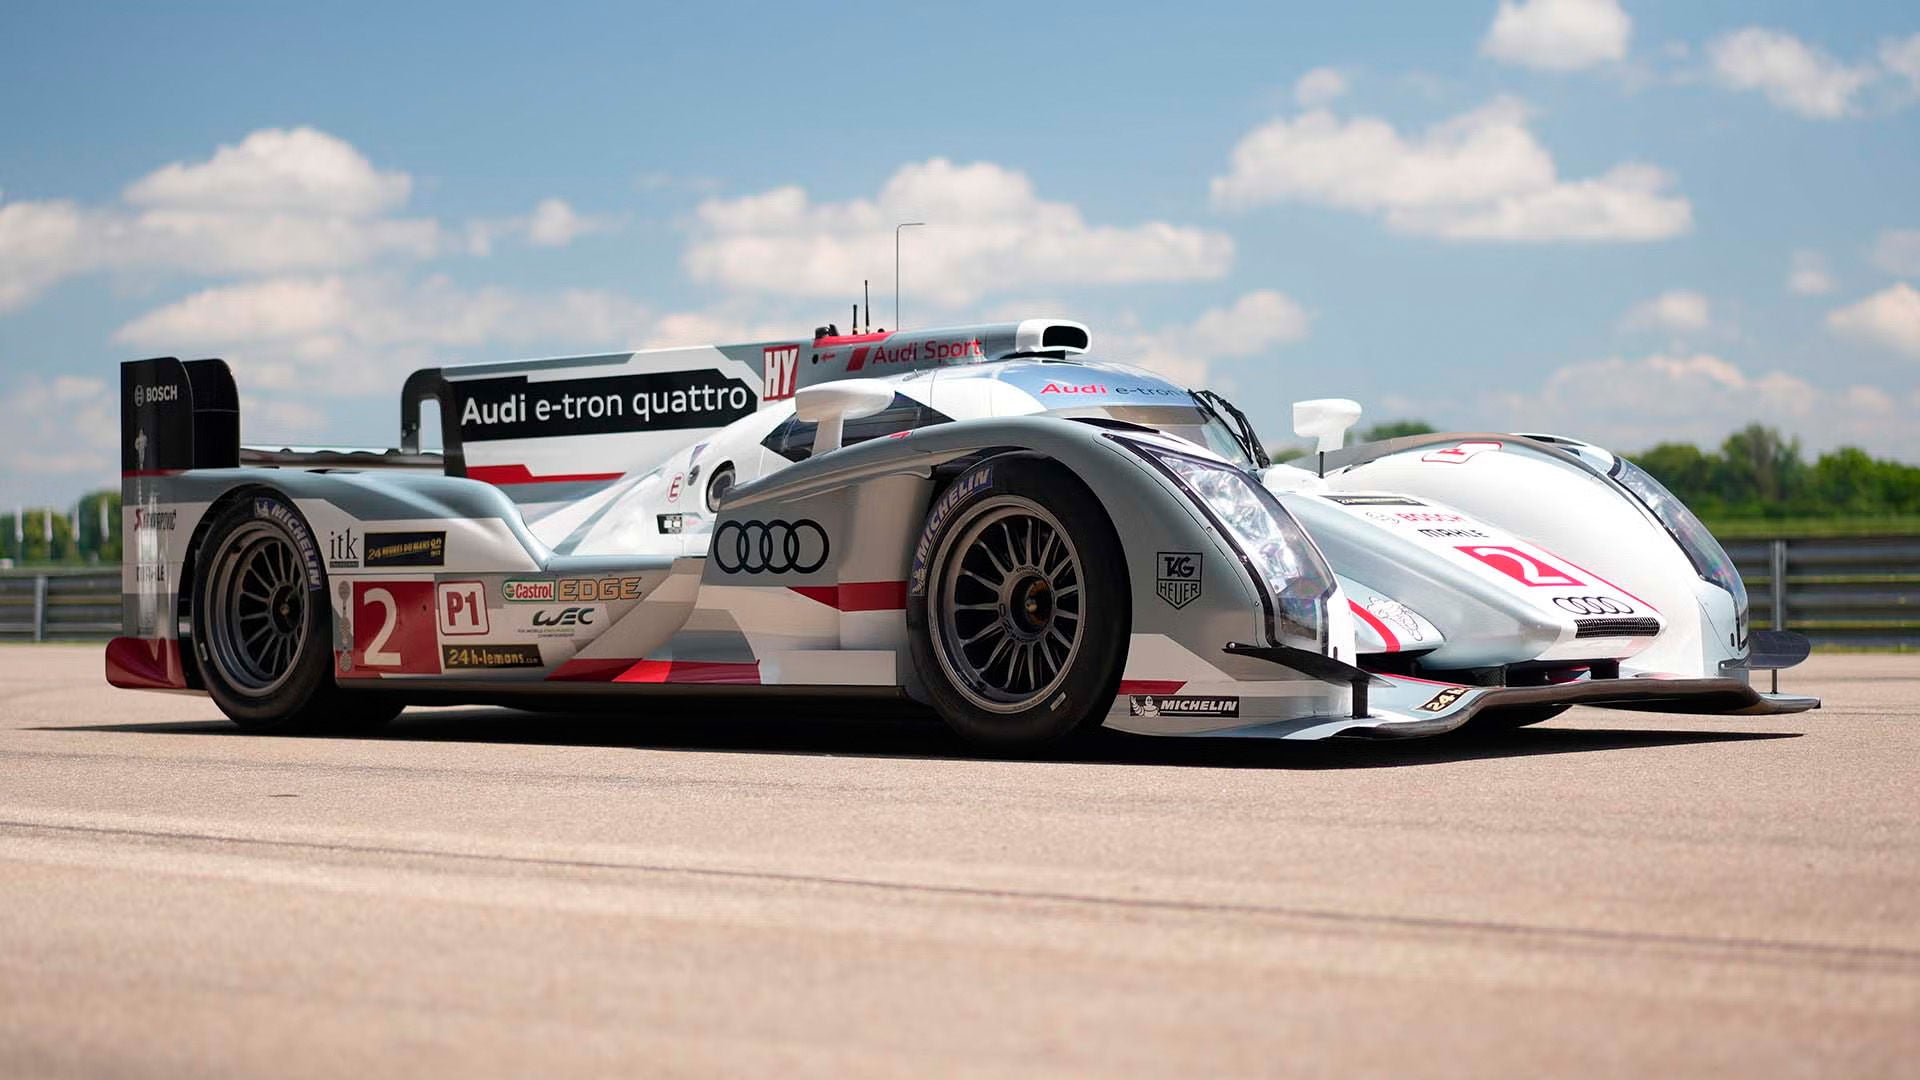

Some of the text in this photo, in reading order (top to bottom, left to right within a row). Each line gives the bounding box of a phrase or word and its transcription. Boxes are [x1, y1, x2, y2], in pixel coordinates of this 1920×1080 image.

[872, 337, 983, 364] Audi Sport
[765, 348, 798, 398] HY
[146, 384, 178, 402] BOSCH
[1040, 383, 1108, 396] Audi
[461, 385, 748, 426] Audi e-tron quattro
[669, 476, 683, 498] E
[917, 468, 990, 562] MICHELIN
[271, 503, 321, 588] MICHELIN
[330, 527, 359, 560] itk
[368, 548, 381, 560] 24
[1164, 556, 1195, 578] TAG
[1473, 547, 1574, 585] 2
[516, 577, 642, 602] Castrol EDGE
[1160, 582, 1198, 605] HEUER
[446, 591, 480, 626] P1
[532, 607, 595, 626] WEC
[364, 587, 401, 666] 2
[1160, 699, 1238, 712] MICHELIN
